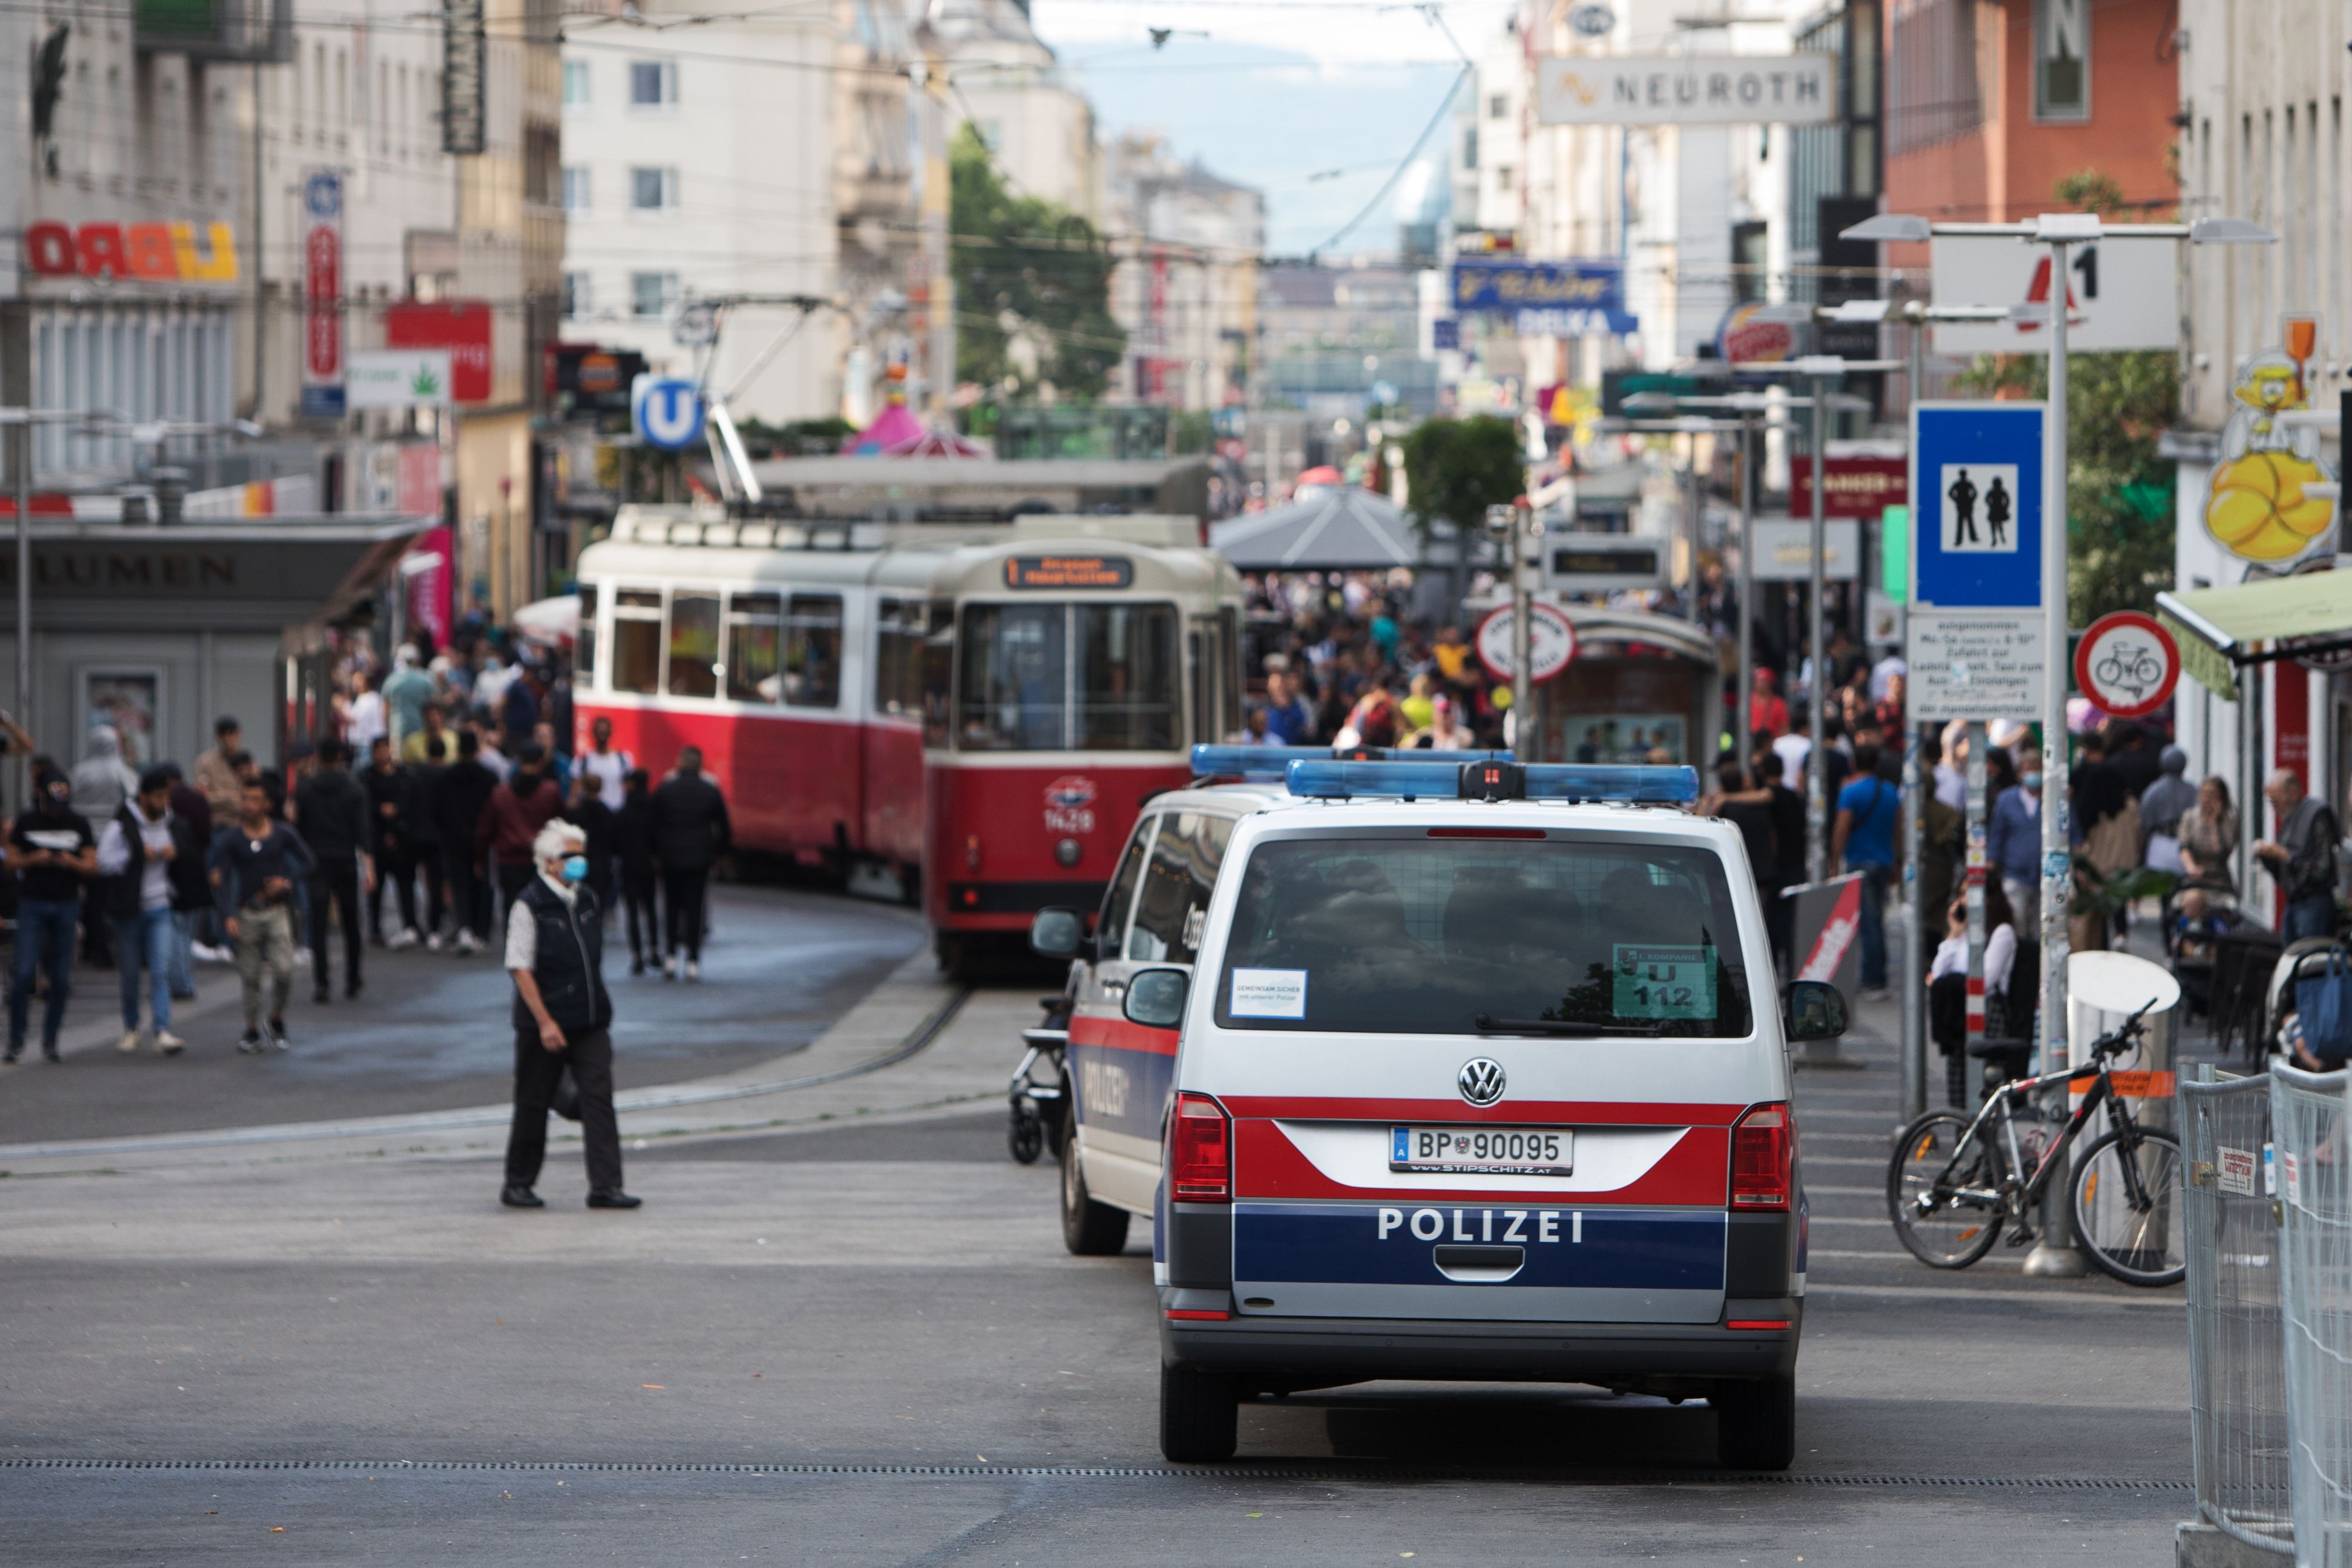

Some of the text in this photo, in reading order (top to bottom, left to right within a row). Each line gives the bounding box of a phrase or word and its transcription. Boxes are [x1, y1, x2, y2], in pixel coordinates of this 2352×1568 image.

[1612, 72, 1822, 106] NEUROTH
[647, 389, 696, 444] U
[1648, 952, 1698, 961] KOMPANIE
[1648, 964, 1676, 982] U
[1633, 985, 1693, 1007] 112
[1419, 1132, 1559, 1161] BP 90095
[1378, 1208, 1583, 1243] POLIZEI
